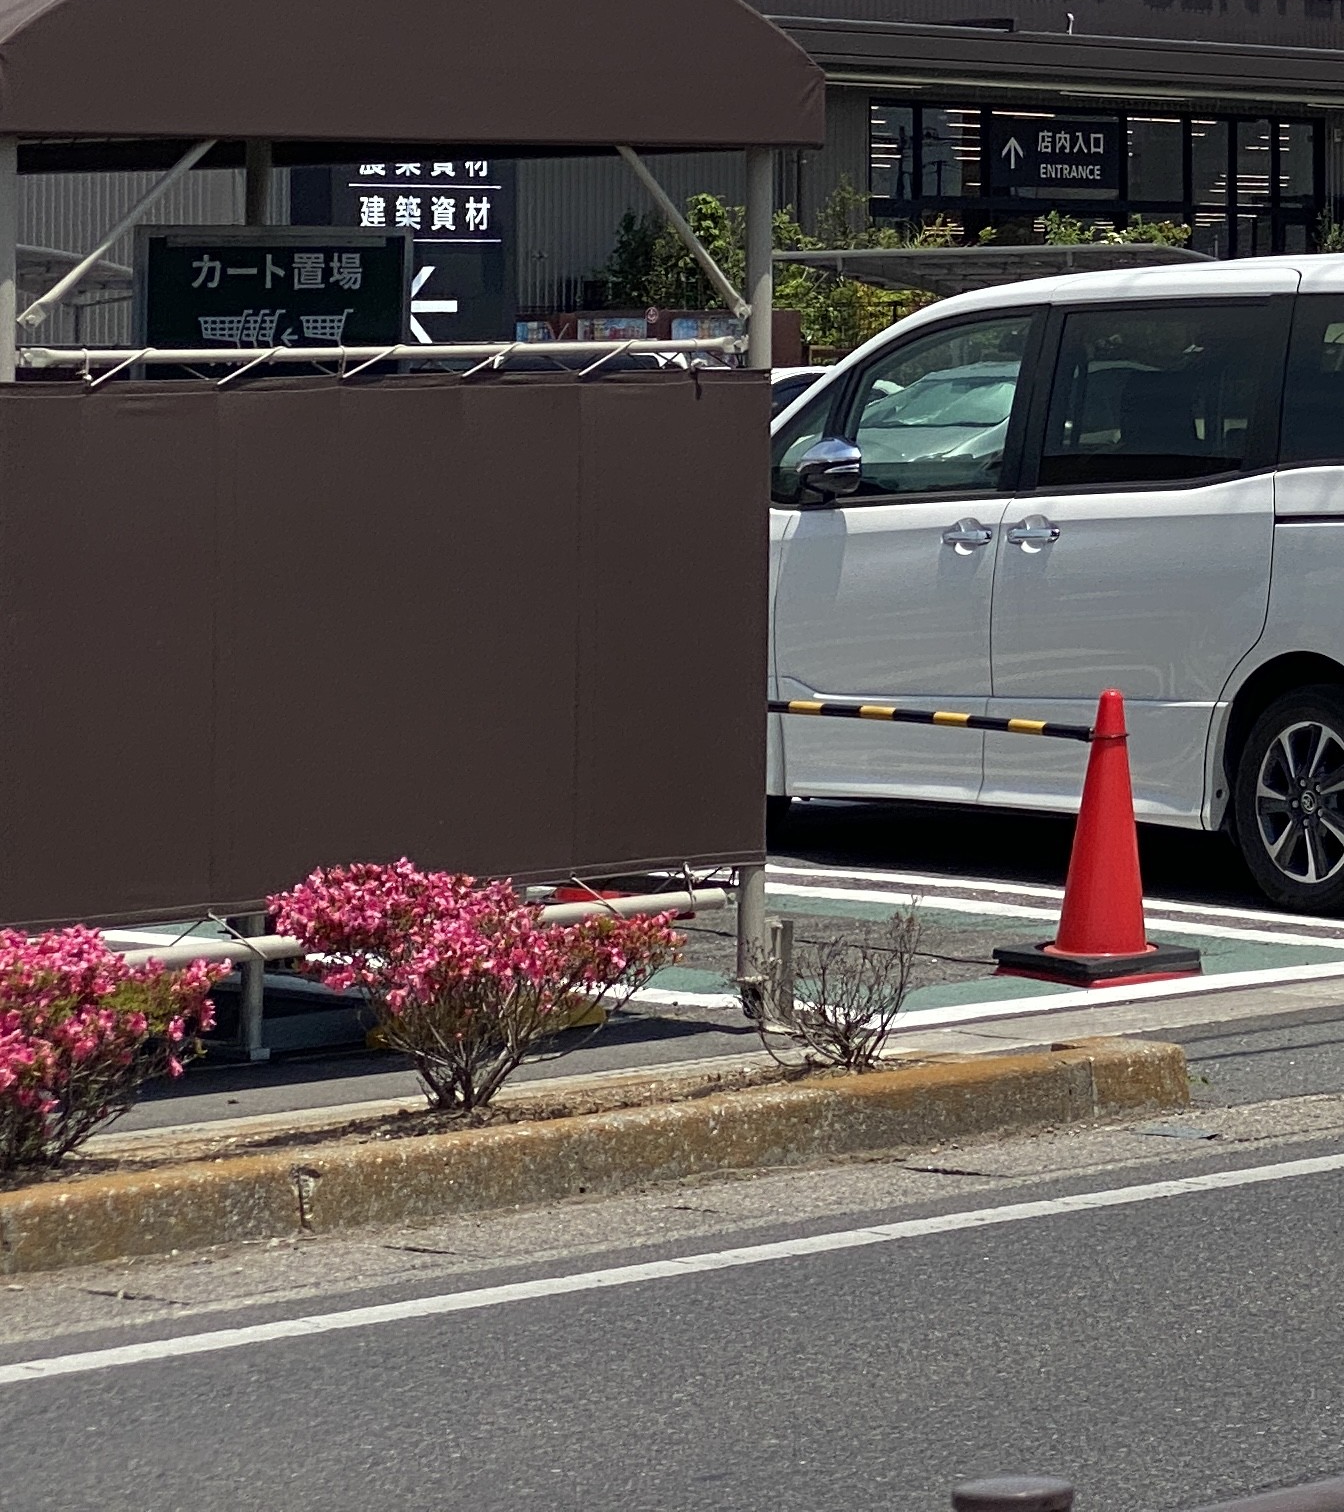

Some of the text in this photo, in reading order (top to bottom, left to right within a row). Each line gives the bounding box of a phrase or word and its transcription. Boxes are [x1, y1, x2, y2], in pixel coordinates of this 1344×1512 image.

[1037, 129, 1104, 154] 店内入口
[1040, 163, 1101, 180] ENTRANCE
[359, 195, 491, 231] 建築資材
[191, 252, 364, 290] カート置場
